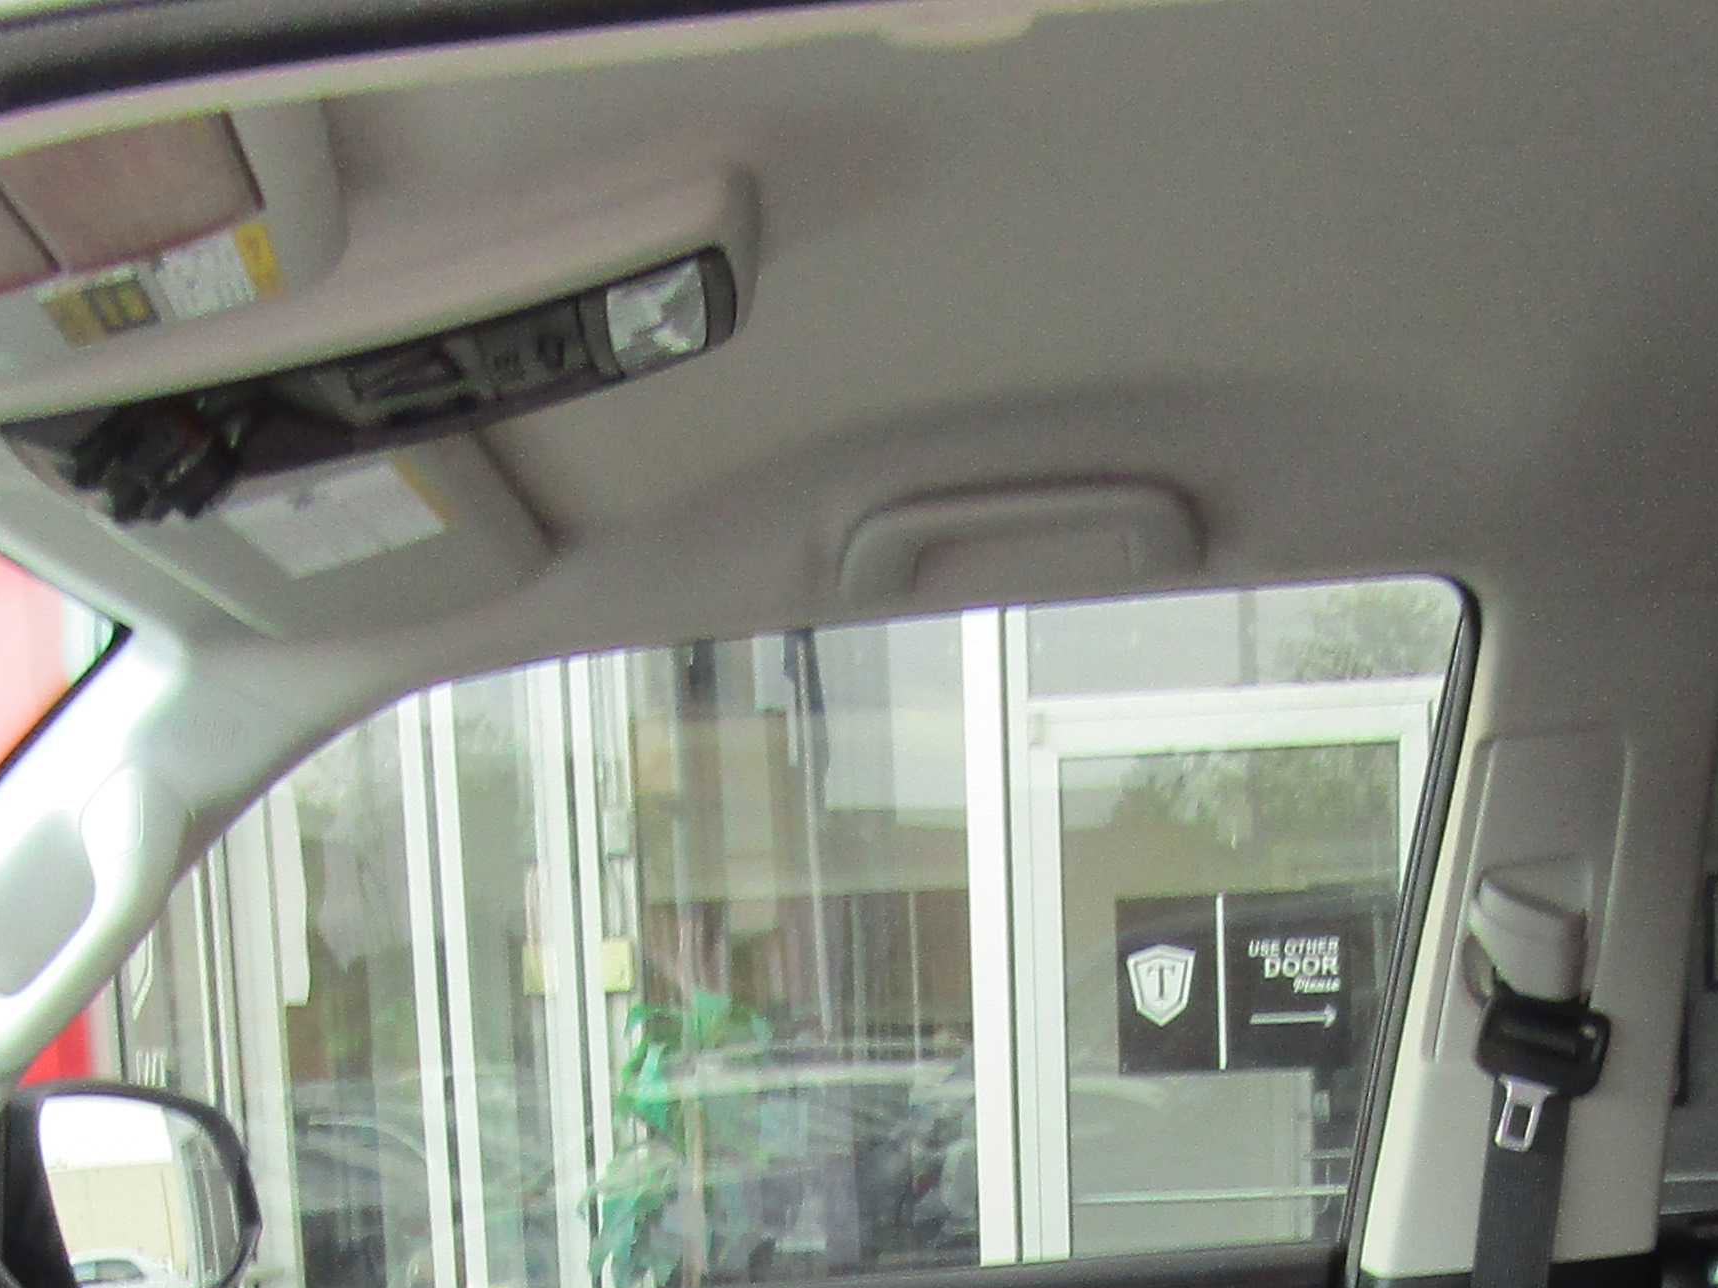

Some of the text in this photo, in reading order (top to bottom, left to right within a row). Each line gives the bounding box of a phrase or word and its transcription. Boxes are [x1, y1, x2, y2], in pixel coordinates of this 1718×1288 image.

[1247, 935, 1340, 958] USE OTHER
[1264, 955, 1340, 978] DOOR
